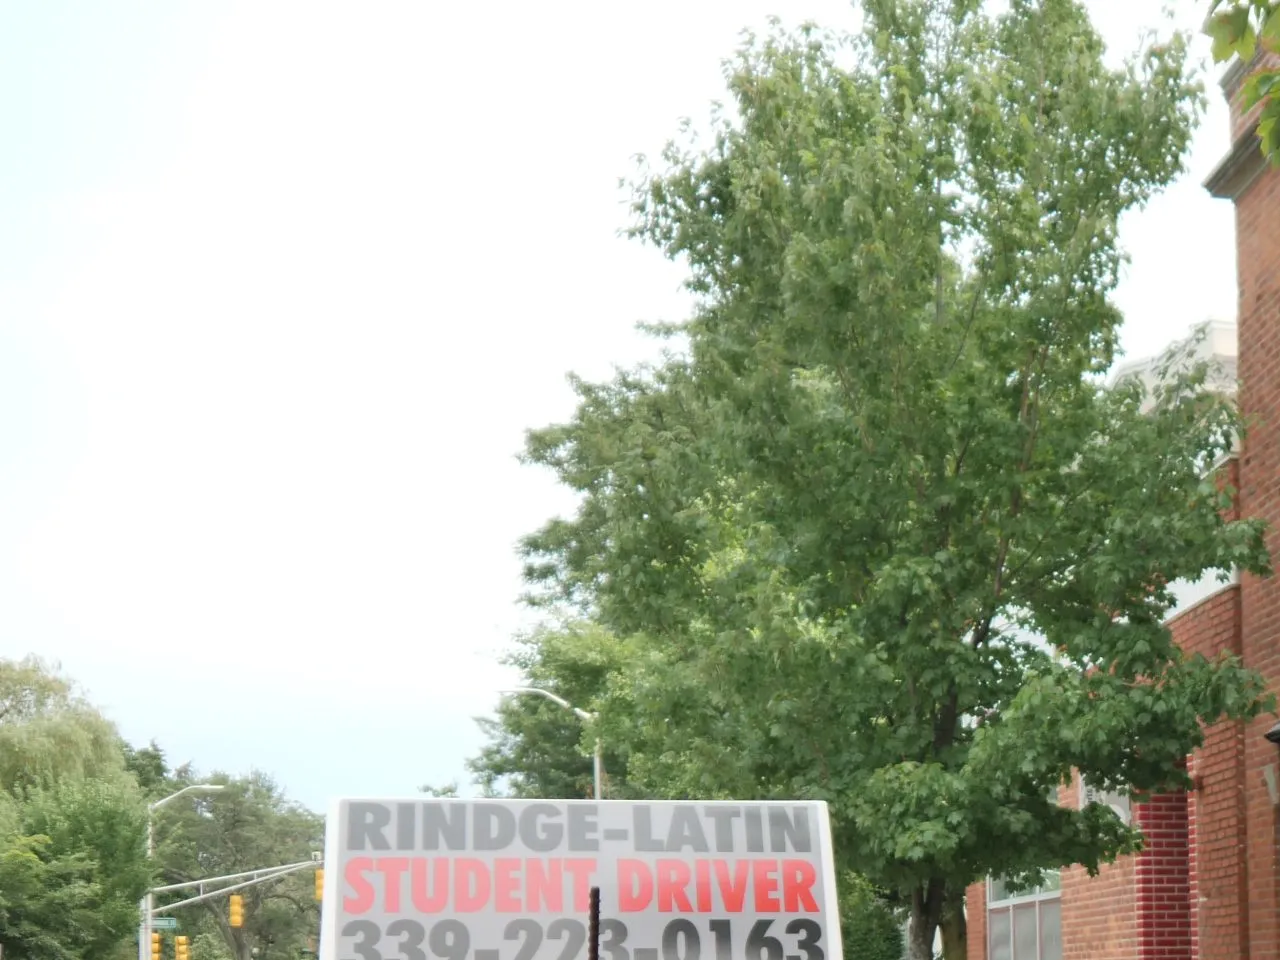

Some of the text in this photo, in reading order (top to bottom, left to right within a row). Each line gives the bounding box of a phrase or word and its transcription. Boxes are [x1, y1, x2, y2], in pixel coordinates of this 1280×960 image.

[346, 802, 812, 853] RINDGE-LATIN
[342, 857, 821, 915] STUDENT DRIVER
